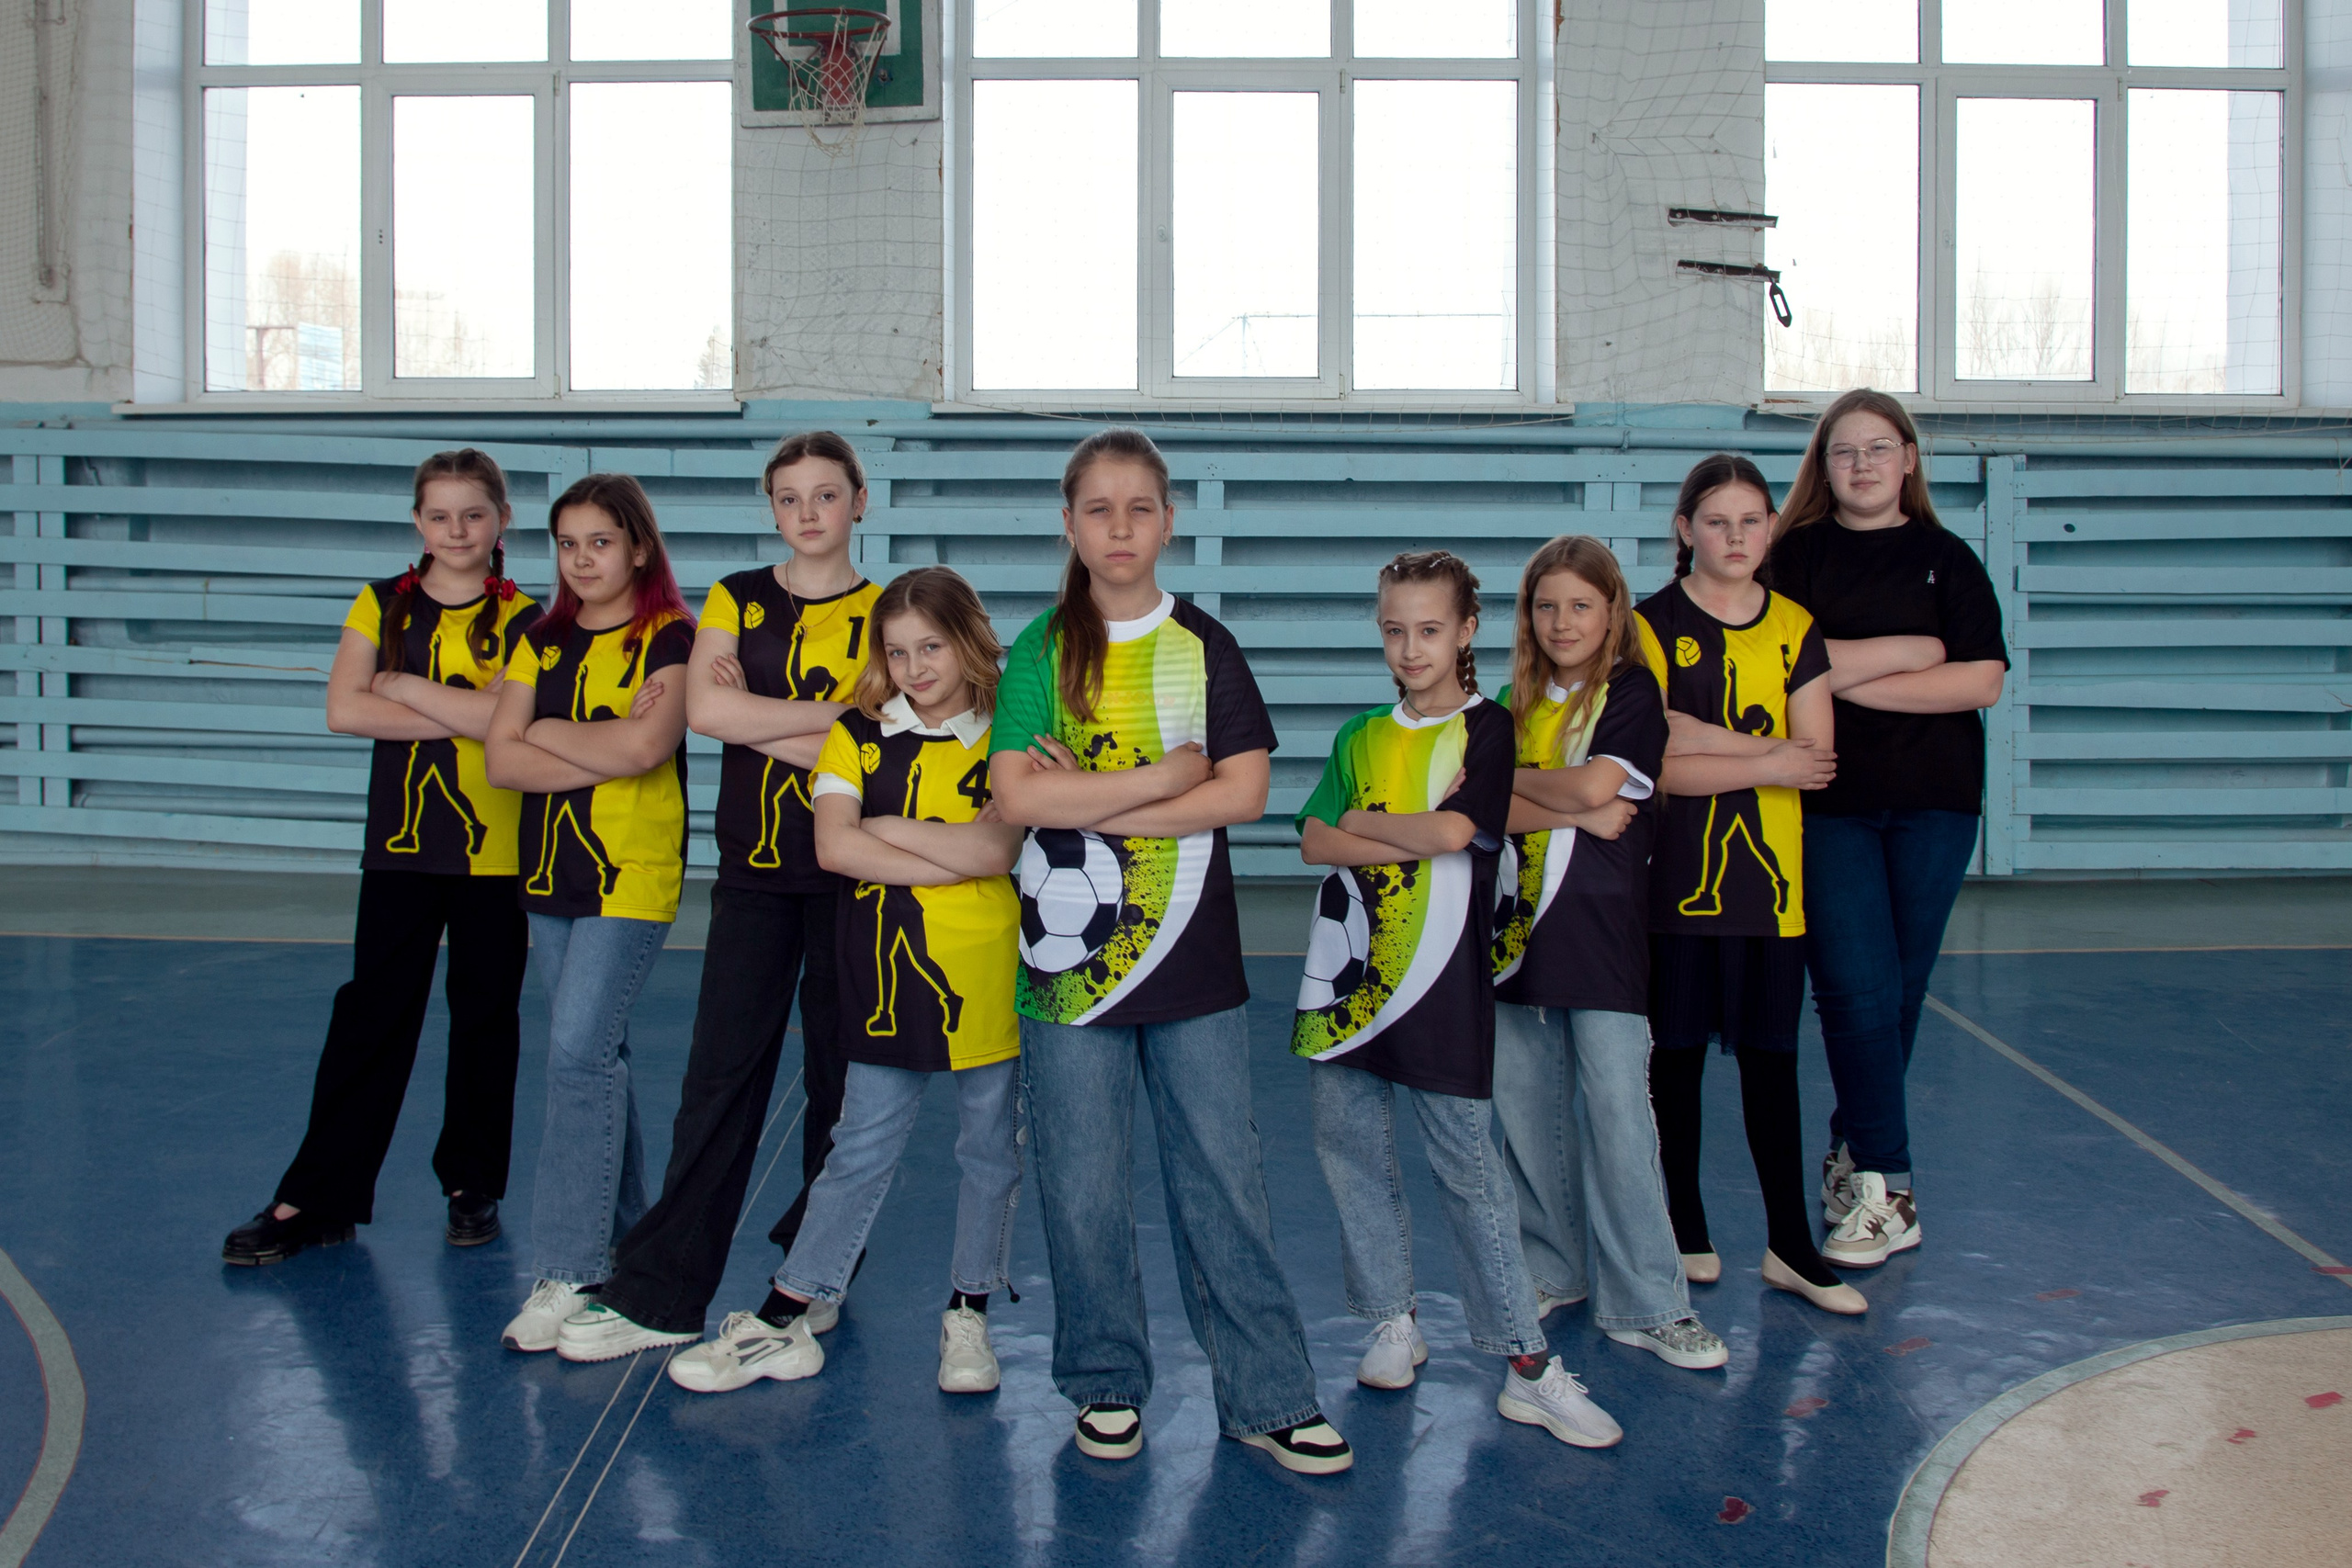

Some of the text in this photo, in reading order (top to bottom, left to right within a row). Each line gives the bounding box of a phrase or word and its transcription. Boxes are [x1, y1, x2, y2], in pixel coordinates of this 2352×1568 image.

[617, 636, 643, 688] 7
[846, 615, 865, 660] 1
[956, 758, 992, 808] 4
